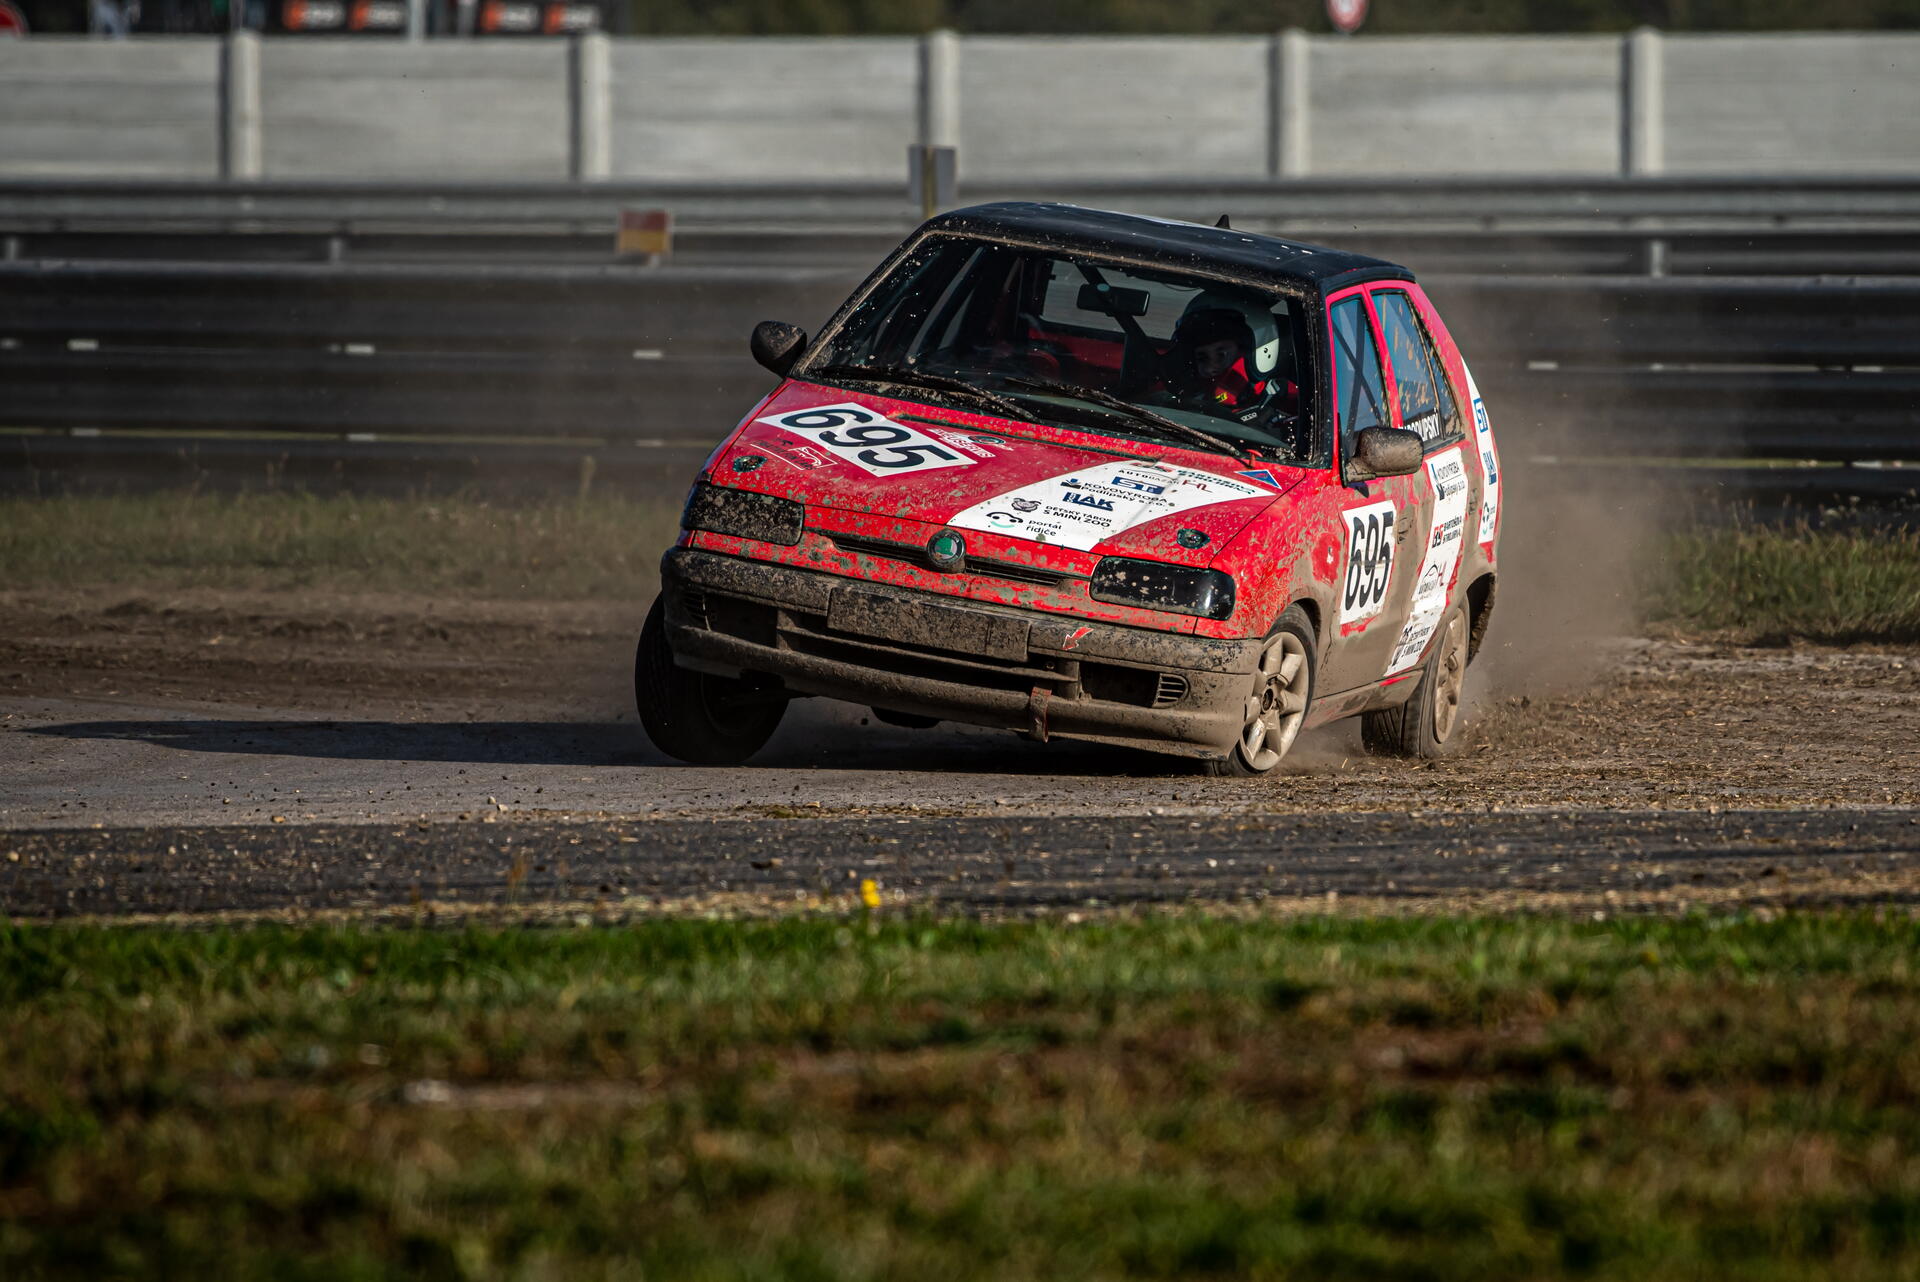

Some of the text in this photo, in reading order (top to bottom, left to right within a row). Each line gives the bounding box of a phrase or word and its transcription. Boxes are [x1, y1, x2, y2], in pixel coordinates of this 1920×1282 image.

[780, 409, 958, 468] 695
[1053, 512, 1081, 521] MINI
[1083, 519, 1111, 528] ZOO
[1345, 511, 1393, 610] 695
